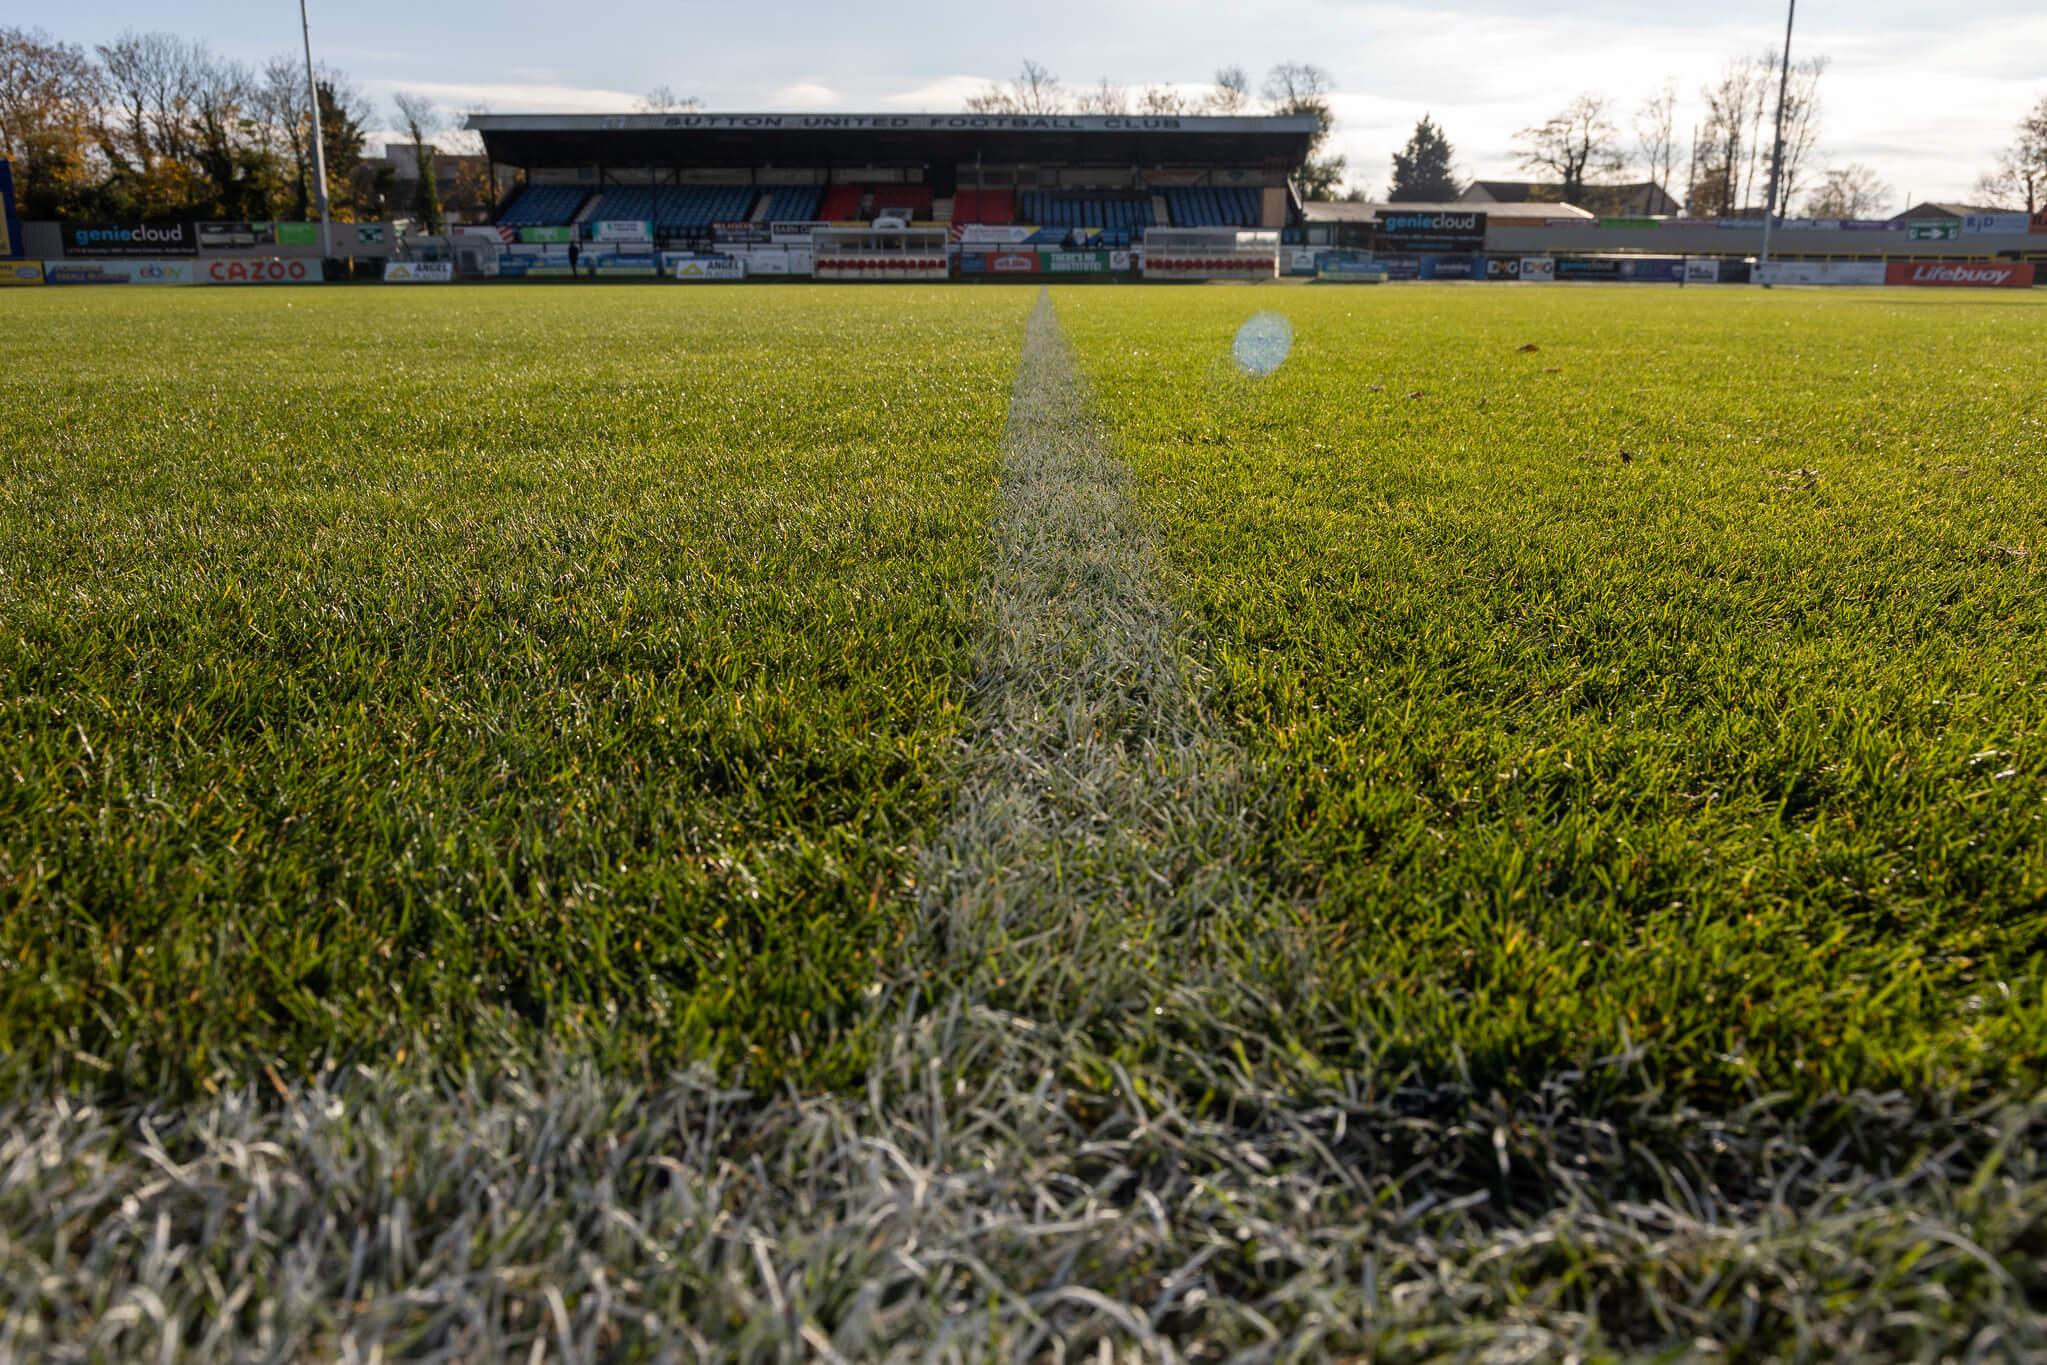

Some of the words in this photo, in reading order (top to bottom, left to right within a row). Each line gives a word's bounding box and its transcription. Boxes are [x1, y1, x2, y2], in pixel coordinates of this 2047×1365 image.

[665, 117, 783, 127] SUTTON
[803, 117, 909, 128] UNITED
[930, 118, 1084, 129] FOOTBALL
[1104, 119, 1182, 129] CLUB
[1385, 213, 1476, 232] geniecloud
[75, 224, 183, 245] geniecloud
[139, 264, 183, 279] ebay
[209, 261, 306, 280] CAZOO
[706, 261, 739, 270] ANGEL
[1912, 265, 2012, 285] Lifebuoy
